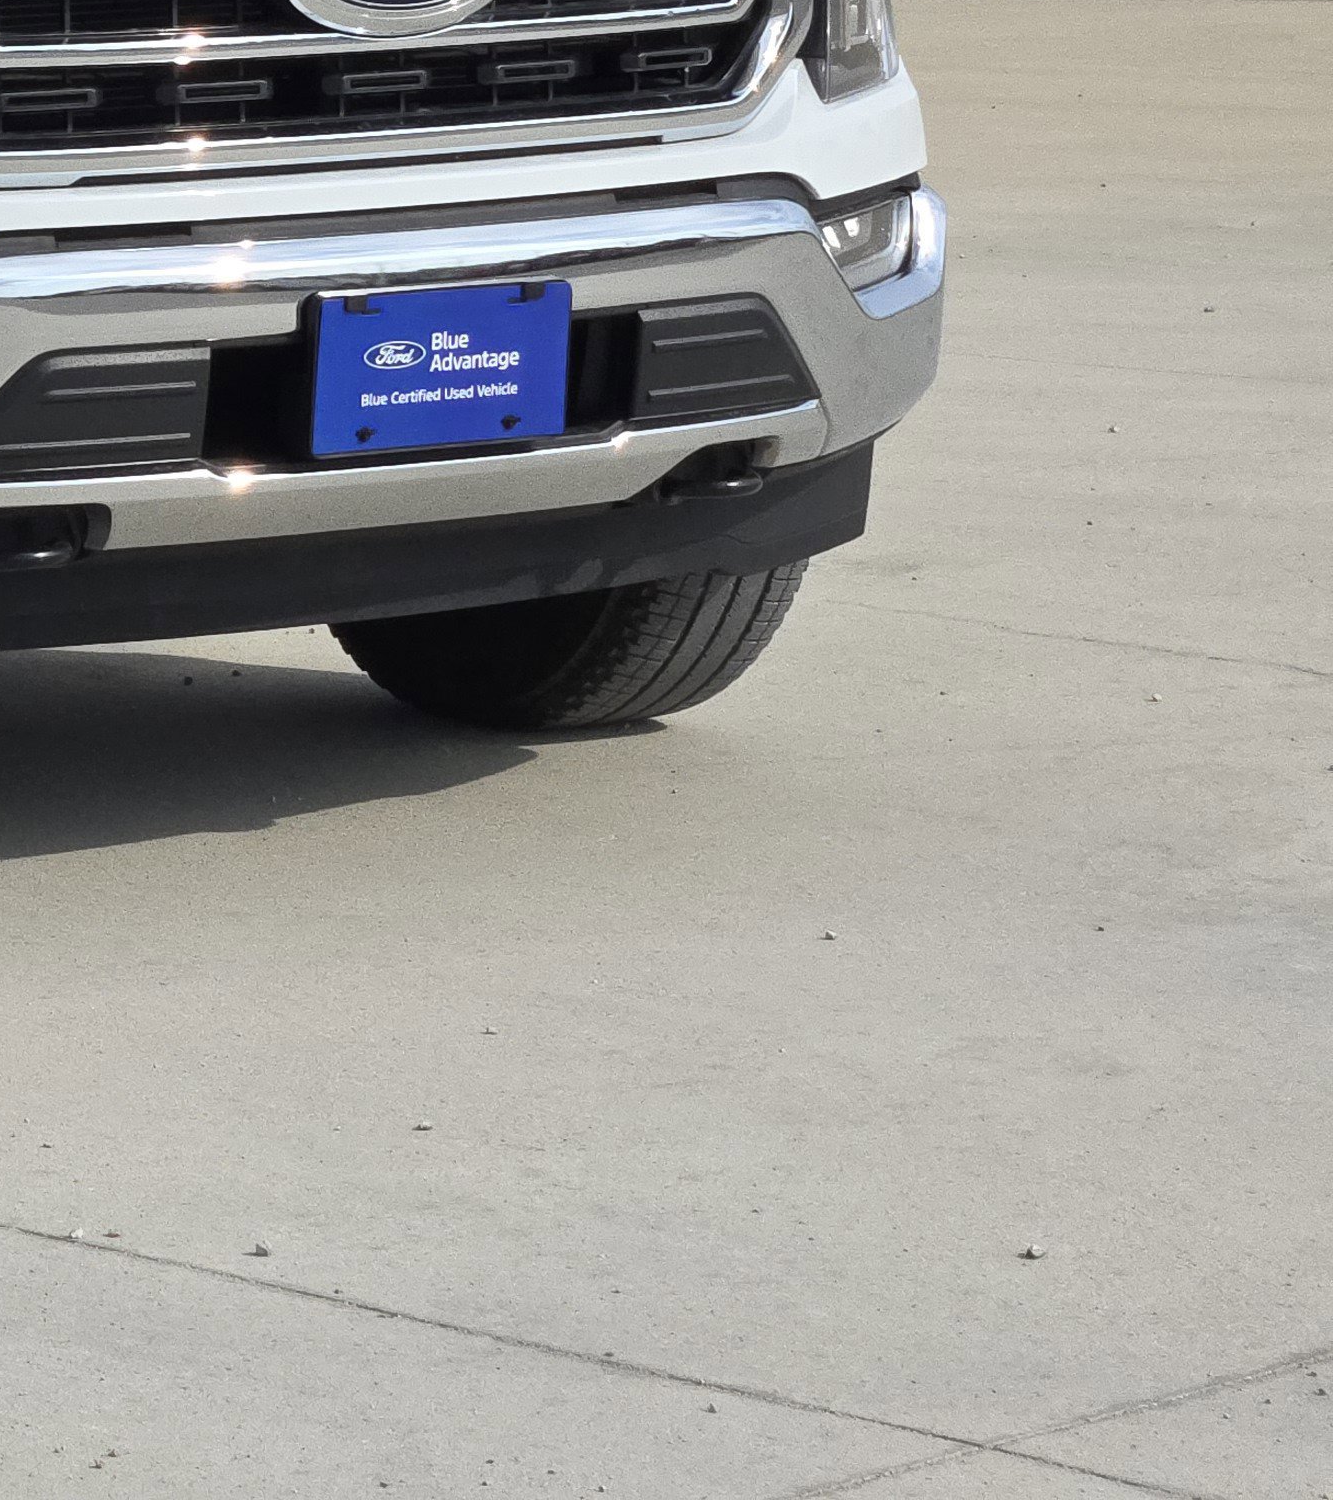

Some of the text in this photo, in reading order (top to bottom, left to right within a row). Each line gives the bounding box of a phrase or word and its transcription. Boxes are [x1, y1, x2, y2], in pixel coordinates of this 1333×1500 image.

[431, 331, 469, 351] Blue
[375, 345, 520, 373] Ford Advantage
[360, 382, 518, 408] Blue Certified Used Vehicle
